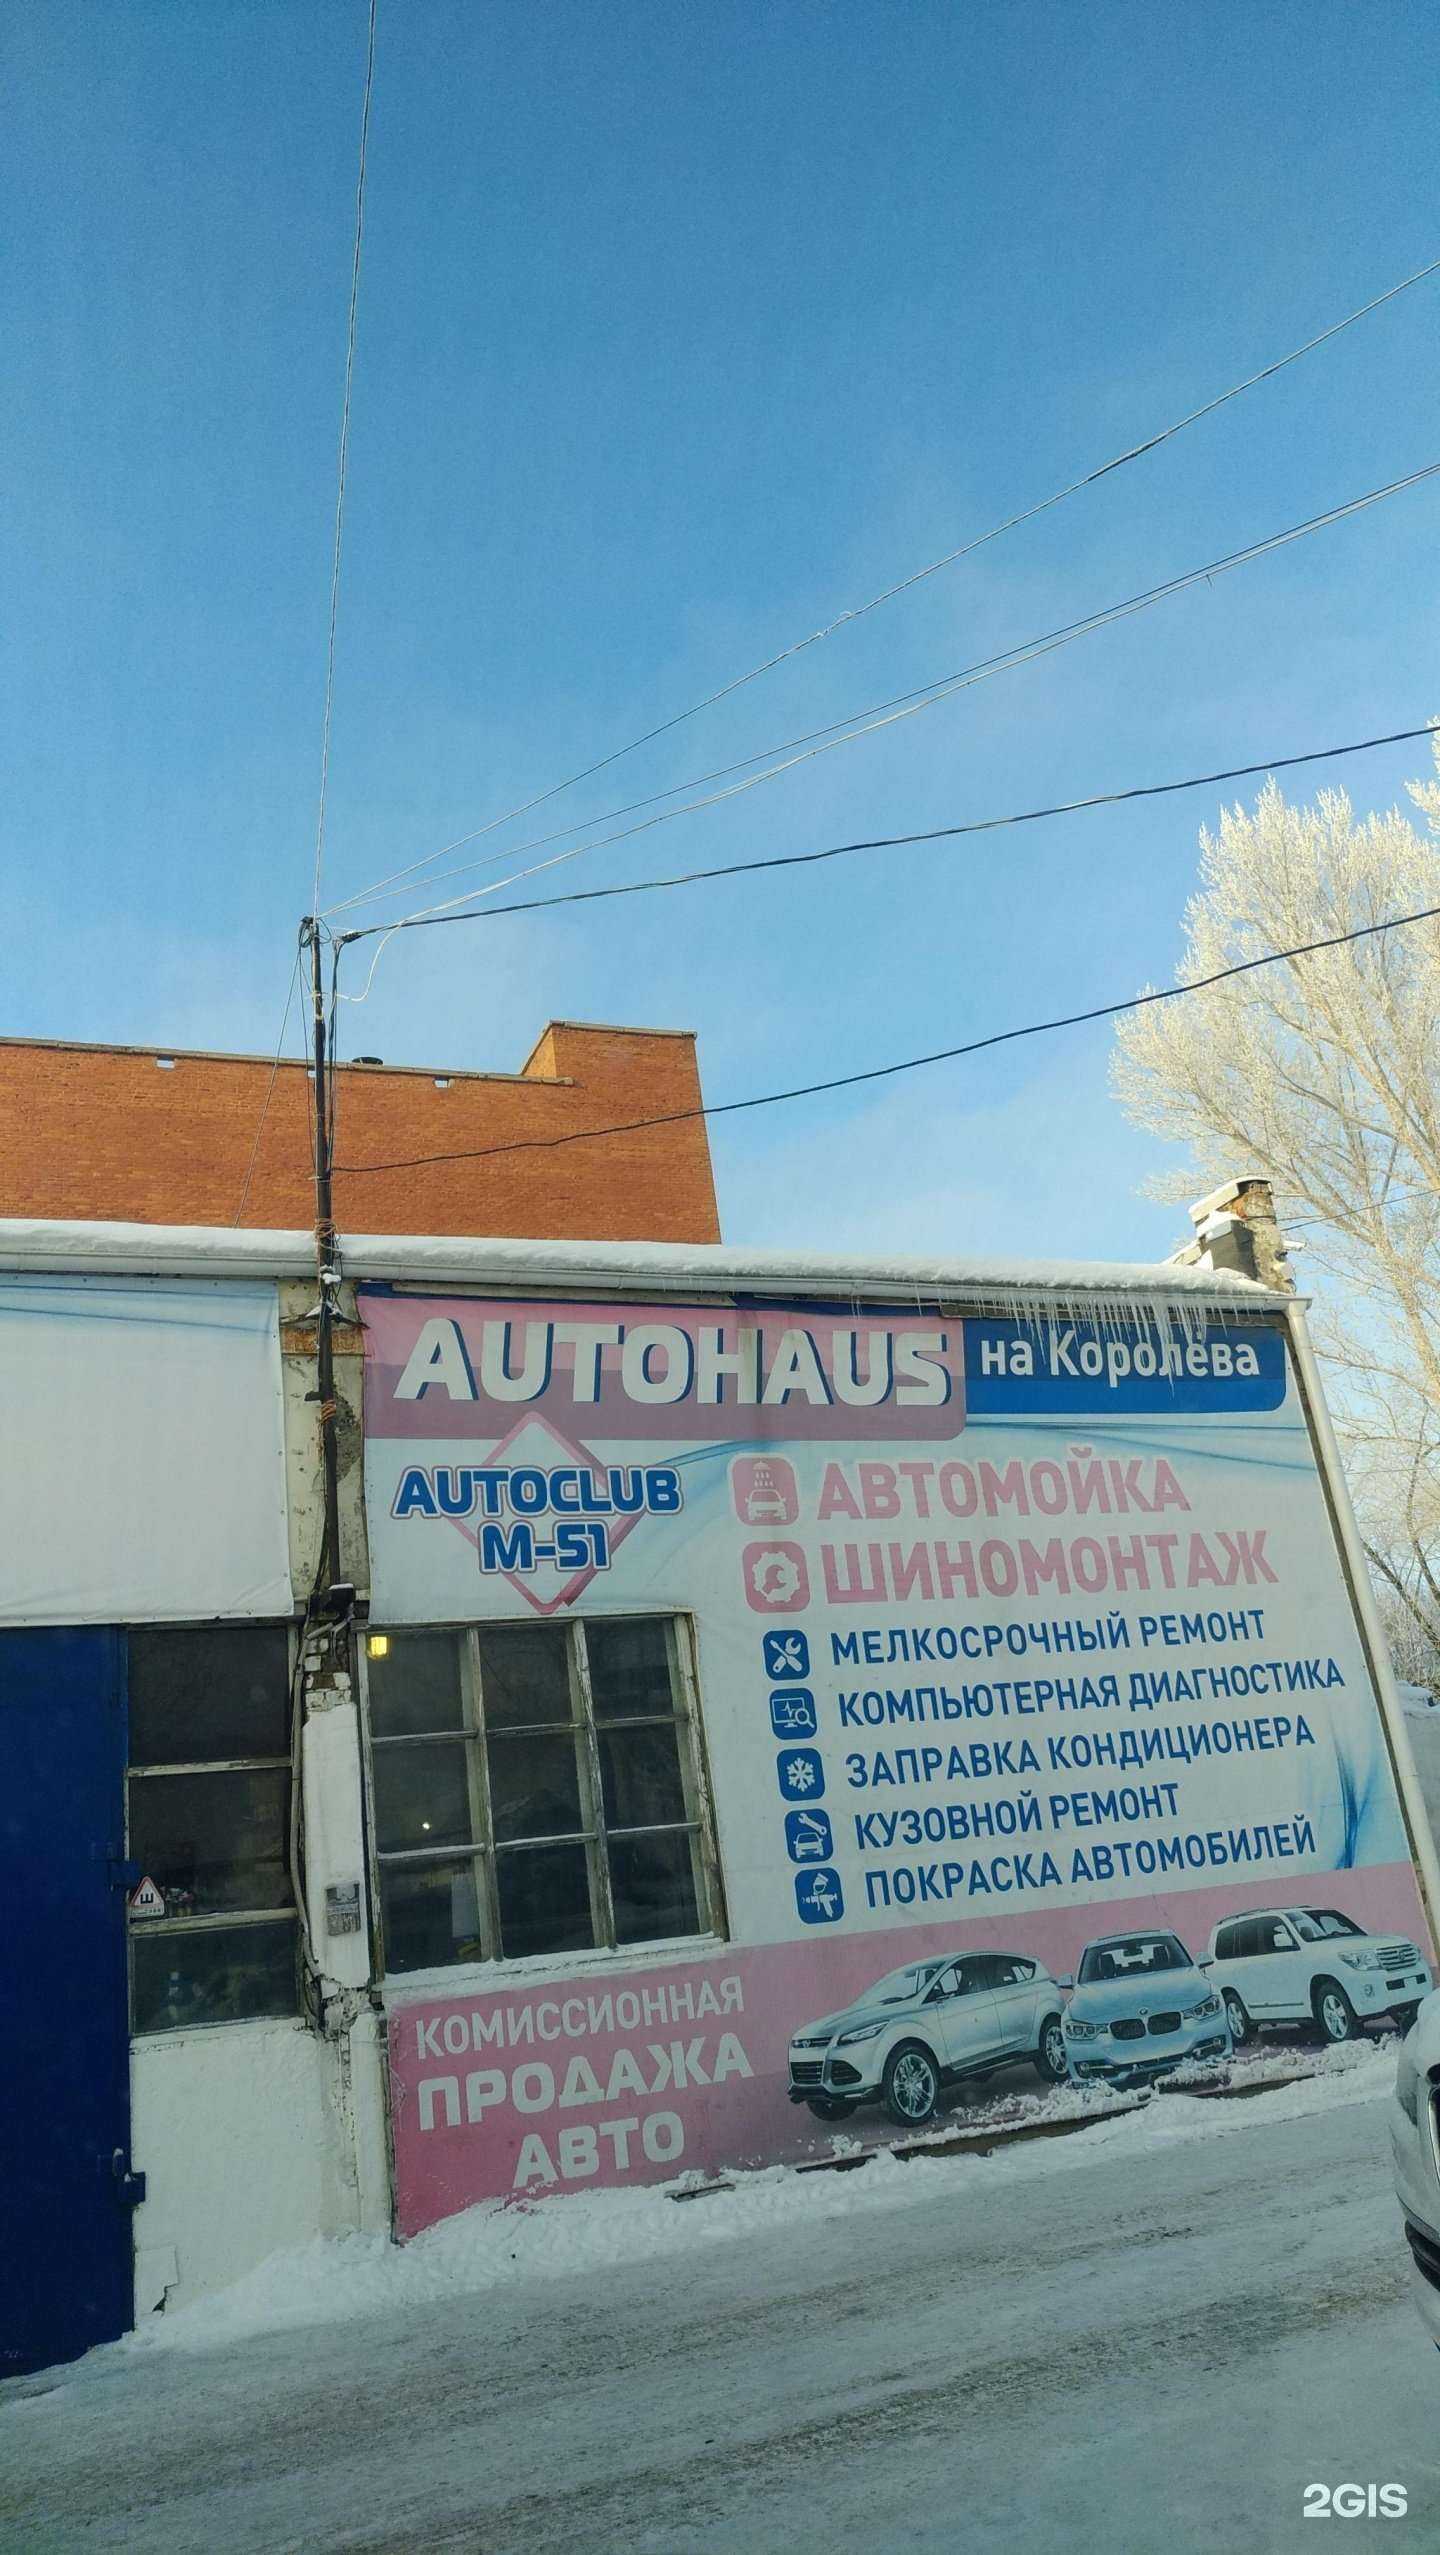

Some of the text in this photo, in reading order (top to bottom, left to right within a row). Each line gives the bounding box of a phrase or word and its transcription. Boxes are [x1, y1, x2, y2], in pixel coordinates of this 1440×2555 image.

[393, 1318, 952, 1406] AUTOHAUS
[980, 1339, 1034, 1376] на
[391, 1465, 684, 1518] AUTOCLUB
[817, 1447, 1191, 1520] АВТОМОЙКА
[479, 1520, 612, 1574] M-51
[821, 1530, 1278, 1604] ШИНОМОНТАЖ
[830, 1609, 1266, 1667] МЕЛКОСРОЧНЫЙ РЕМОНТ
[837, 1657, 1346, 1728] КОМПЬЮТЕРНАЯ ДИАГНОСТИКА
[845, 1714, 1316, 1789] ЗАПРАВКА КОНДИЦИОНЕРА
[854, 1782, 1180, 1850] КУЗОВНОЙ РЕМОНТ
[865, 1814, 1317, 1908] ПОКРАСКА АВТОМОБИЛЕЙ
[415, 1975, 746, 2060] КОМИССИОННАЯ
[418, 2033, 754, 2130] ПРОДАЖА
[512, 2111, 686, 2188] АВТО
